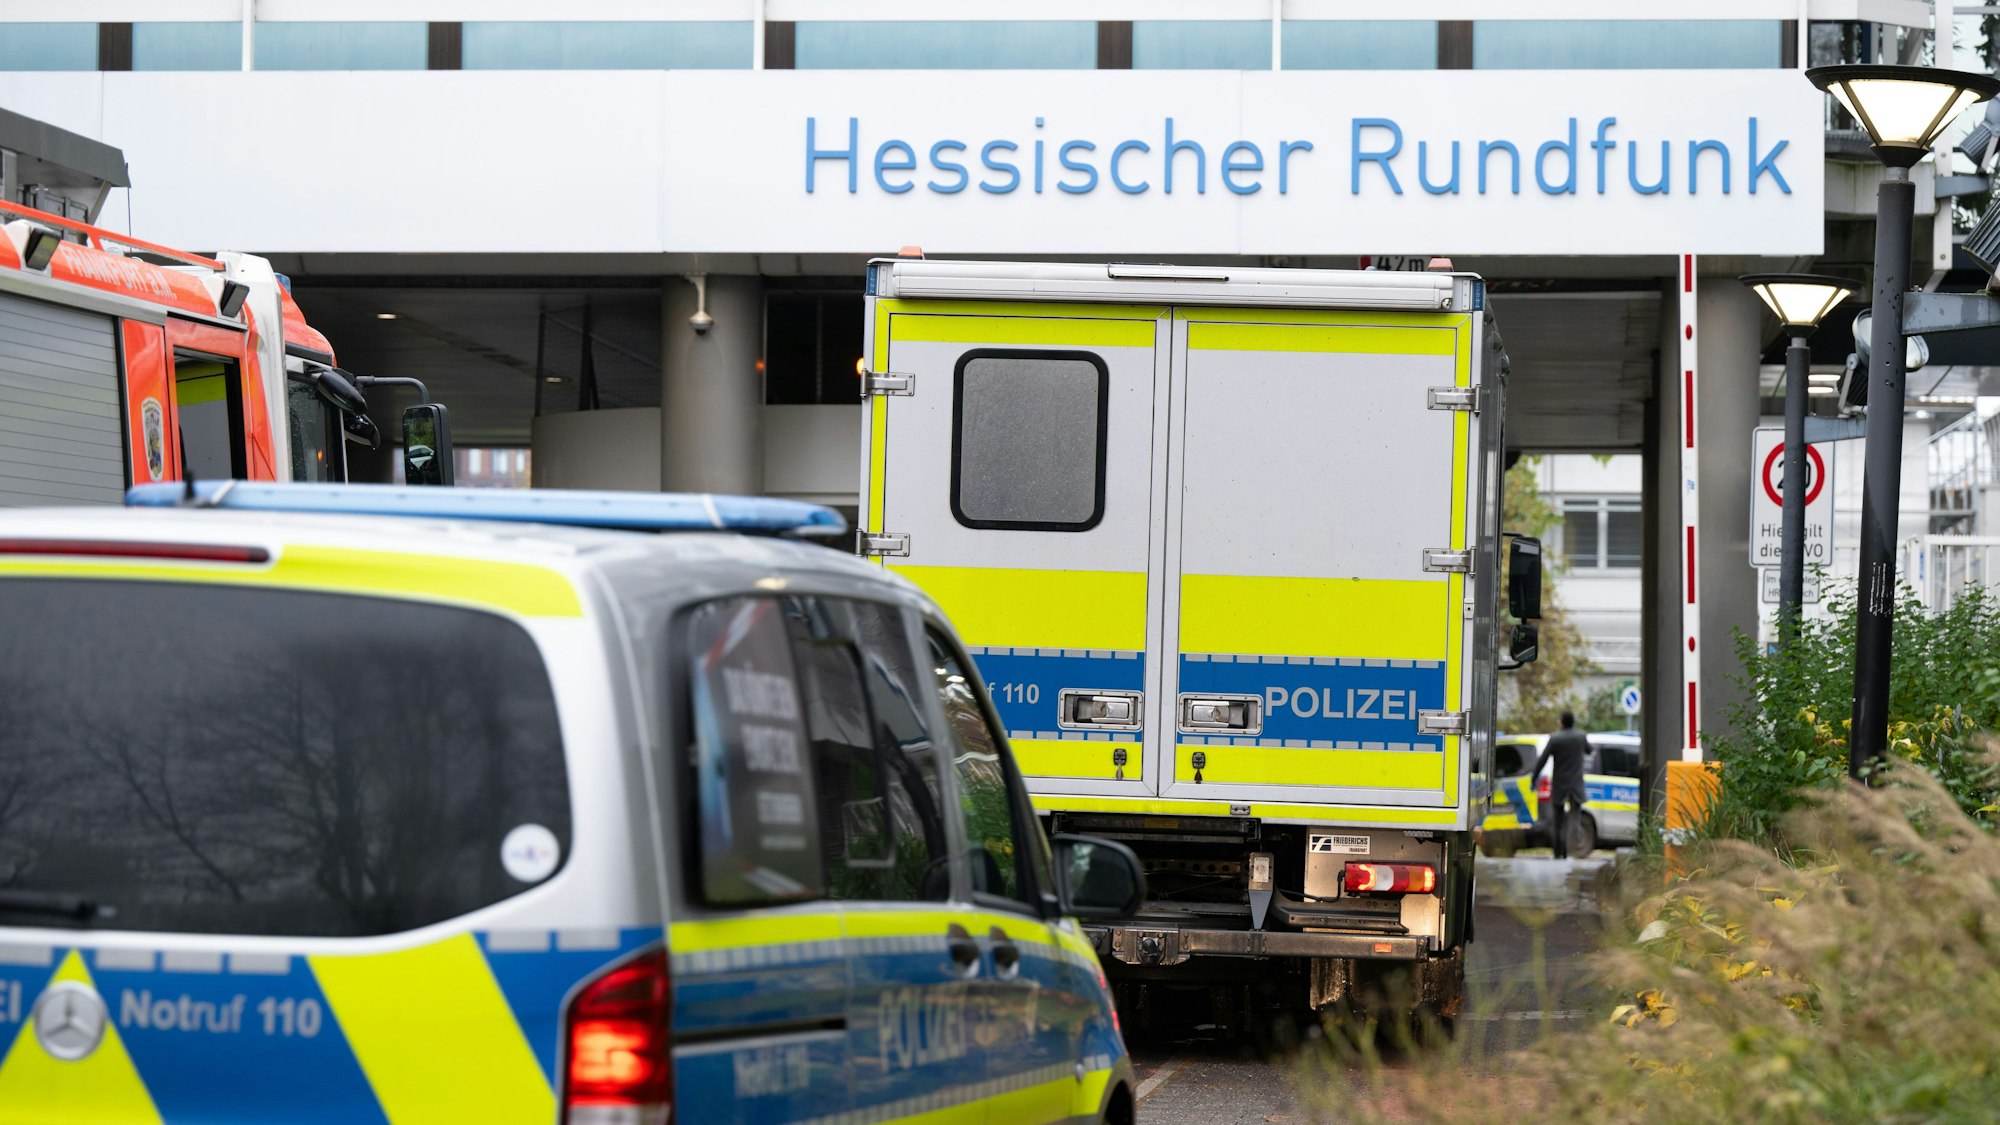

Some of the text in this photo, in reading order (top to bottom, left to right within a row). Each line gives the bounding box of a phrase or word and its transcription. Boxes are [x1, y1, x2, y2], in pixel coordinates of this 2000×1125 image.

[806, 117, 1791, 194] Hessischer Rundfunk
[1761, 523, 1783, 537] Hie
[1760, 543, 1823, 557] die VO
[1003, 683, 1040, 704] 110
[1264, 686, 1416, 720] POLIZEI
[121, 988, 322, 1038] Notruf 110
[879, 983, 967, 1073] POLIZEI
